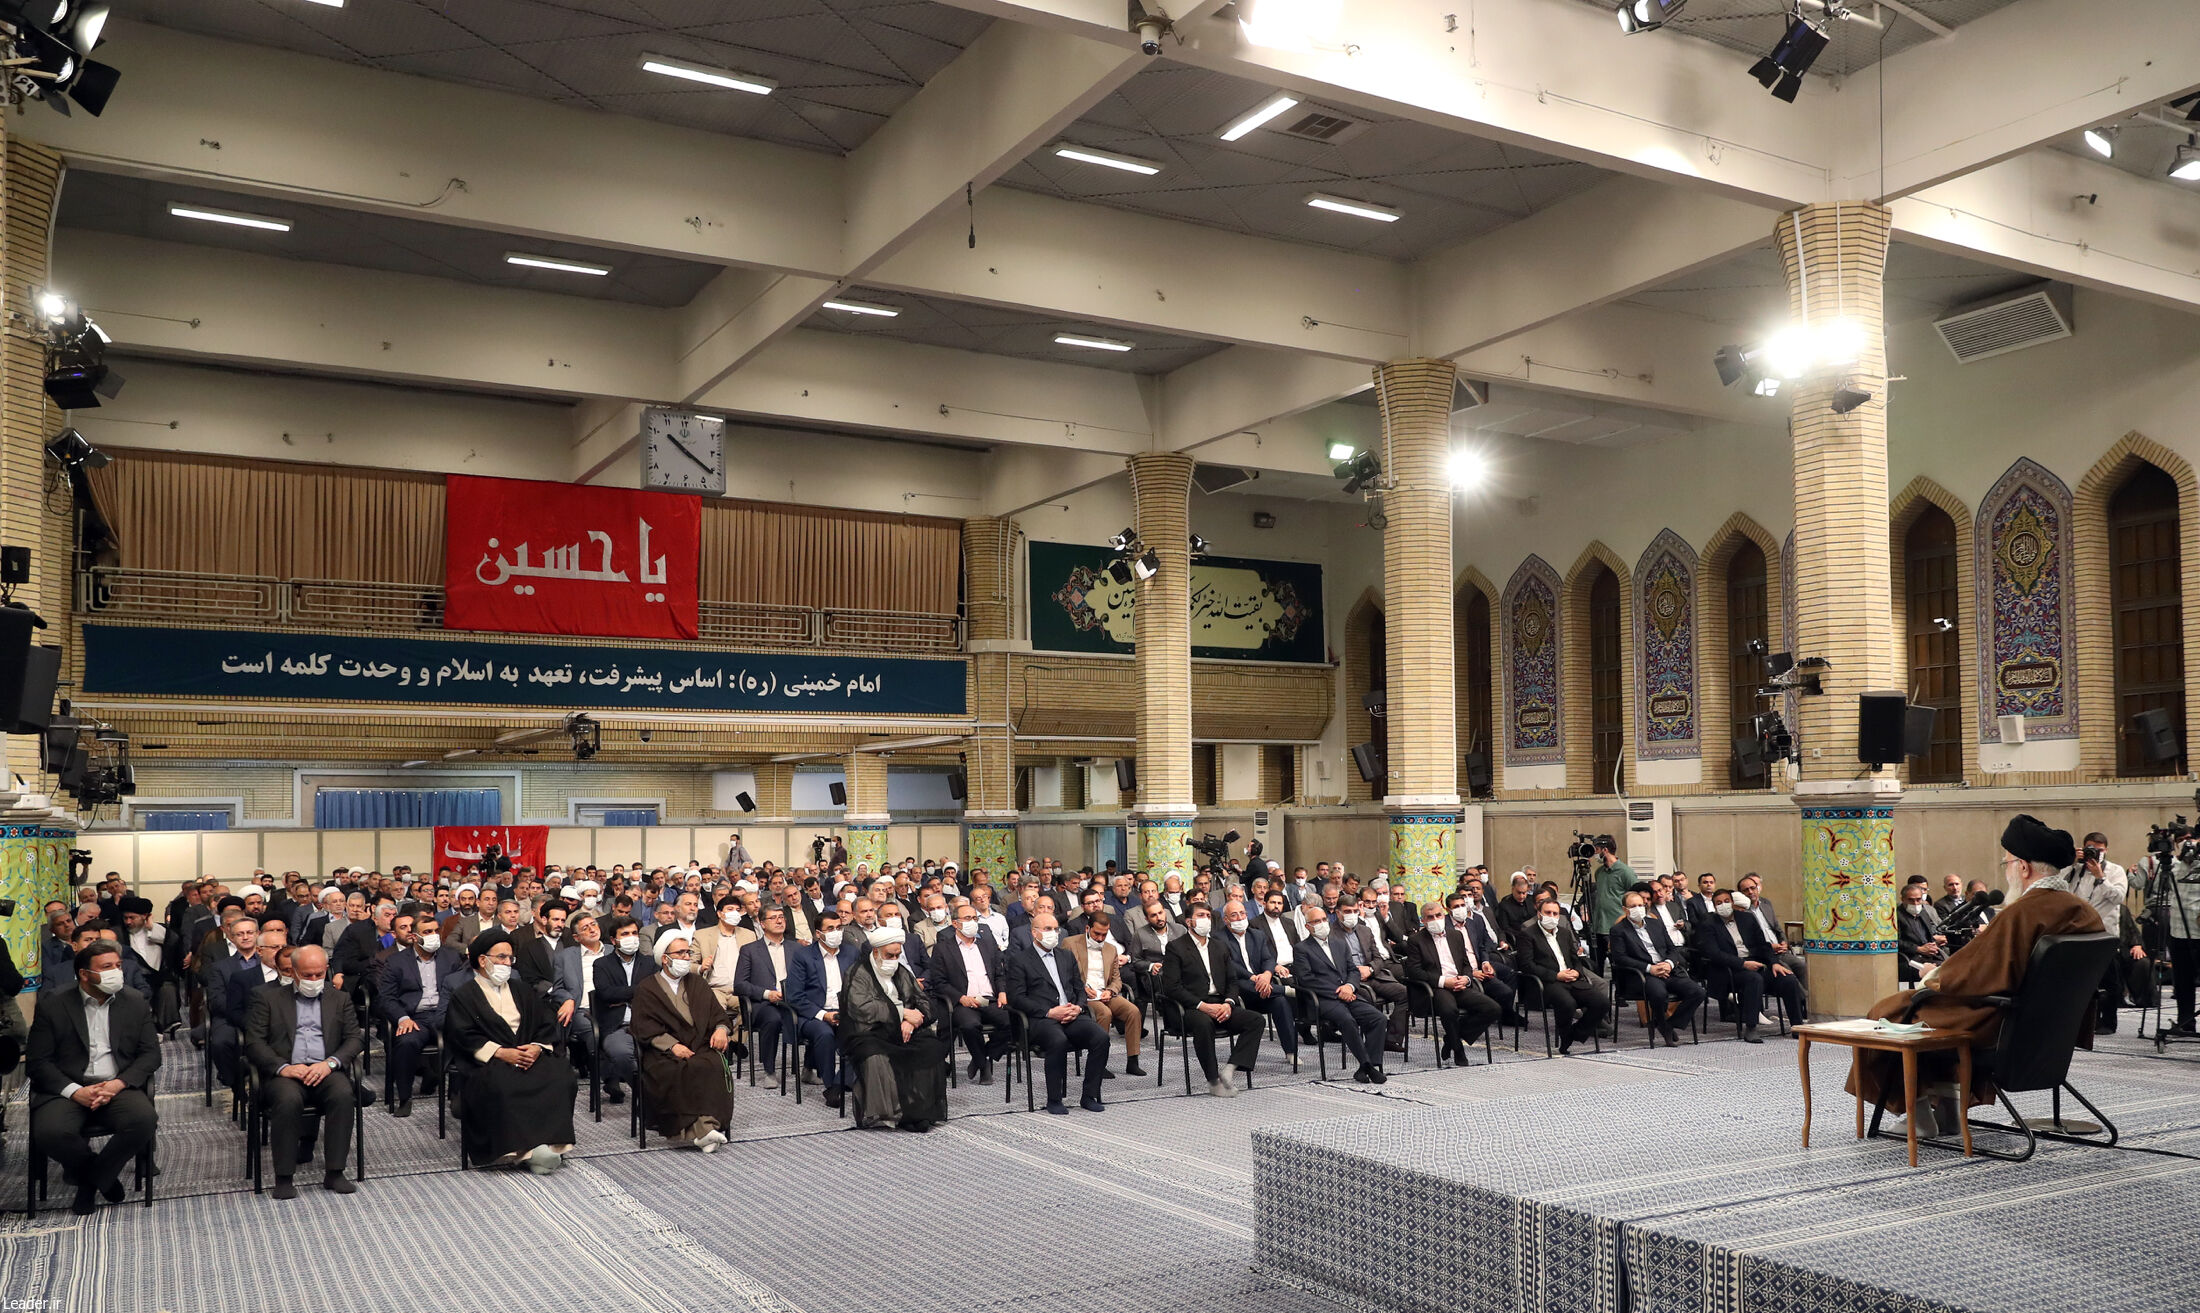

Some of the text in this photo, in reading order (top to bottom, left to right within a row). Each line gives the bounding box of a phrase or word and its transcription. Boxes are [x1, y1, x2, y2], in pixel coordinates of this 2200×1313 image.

[475, 516, 667, 603] یا حسین
[222, 651, 273, 675] است
[280, 653, 332, 676] کلمه
[338, 659, 411, 686] وحدت
[436, 659, 493, 687] اسلام
[417, 667, 430, 687] و
[499, 664, 520, 688] به
[528, 664, 573, 688] تعهد
[669, 667, 723, 694] اساس
[729, 668, 777, 695] (ره):
[783, 672, 842, 697] خمینی
[846, 673, 881, 697] امام
